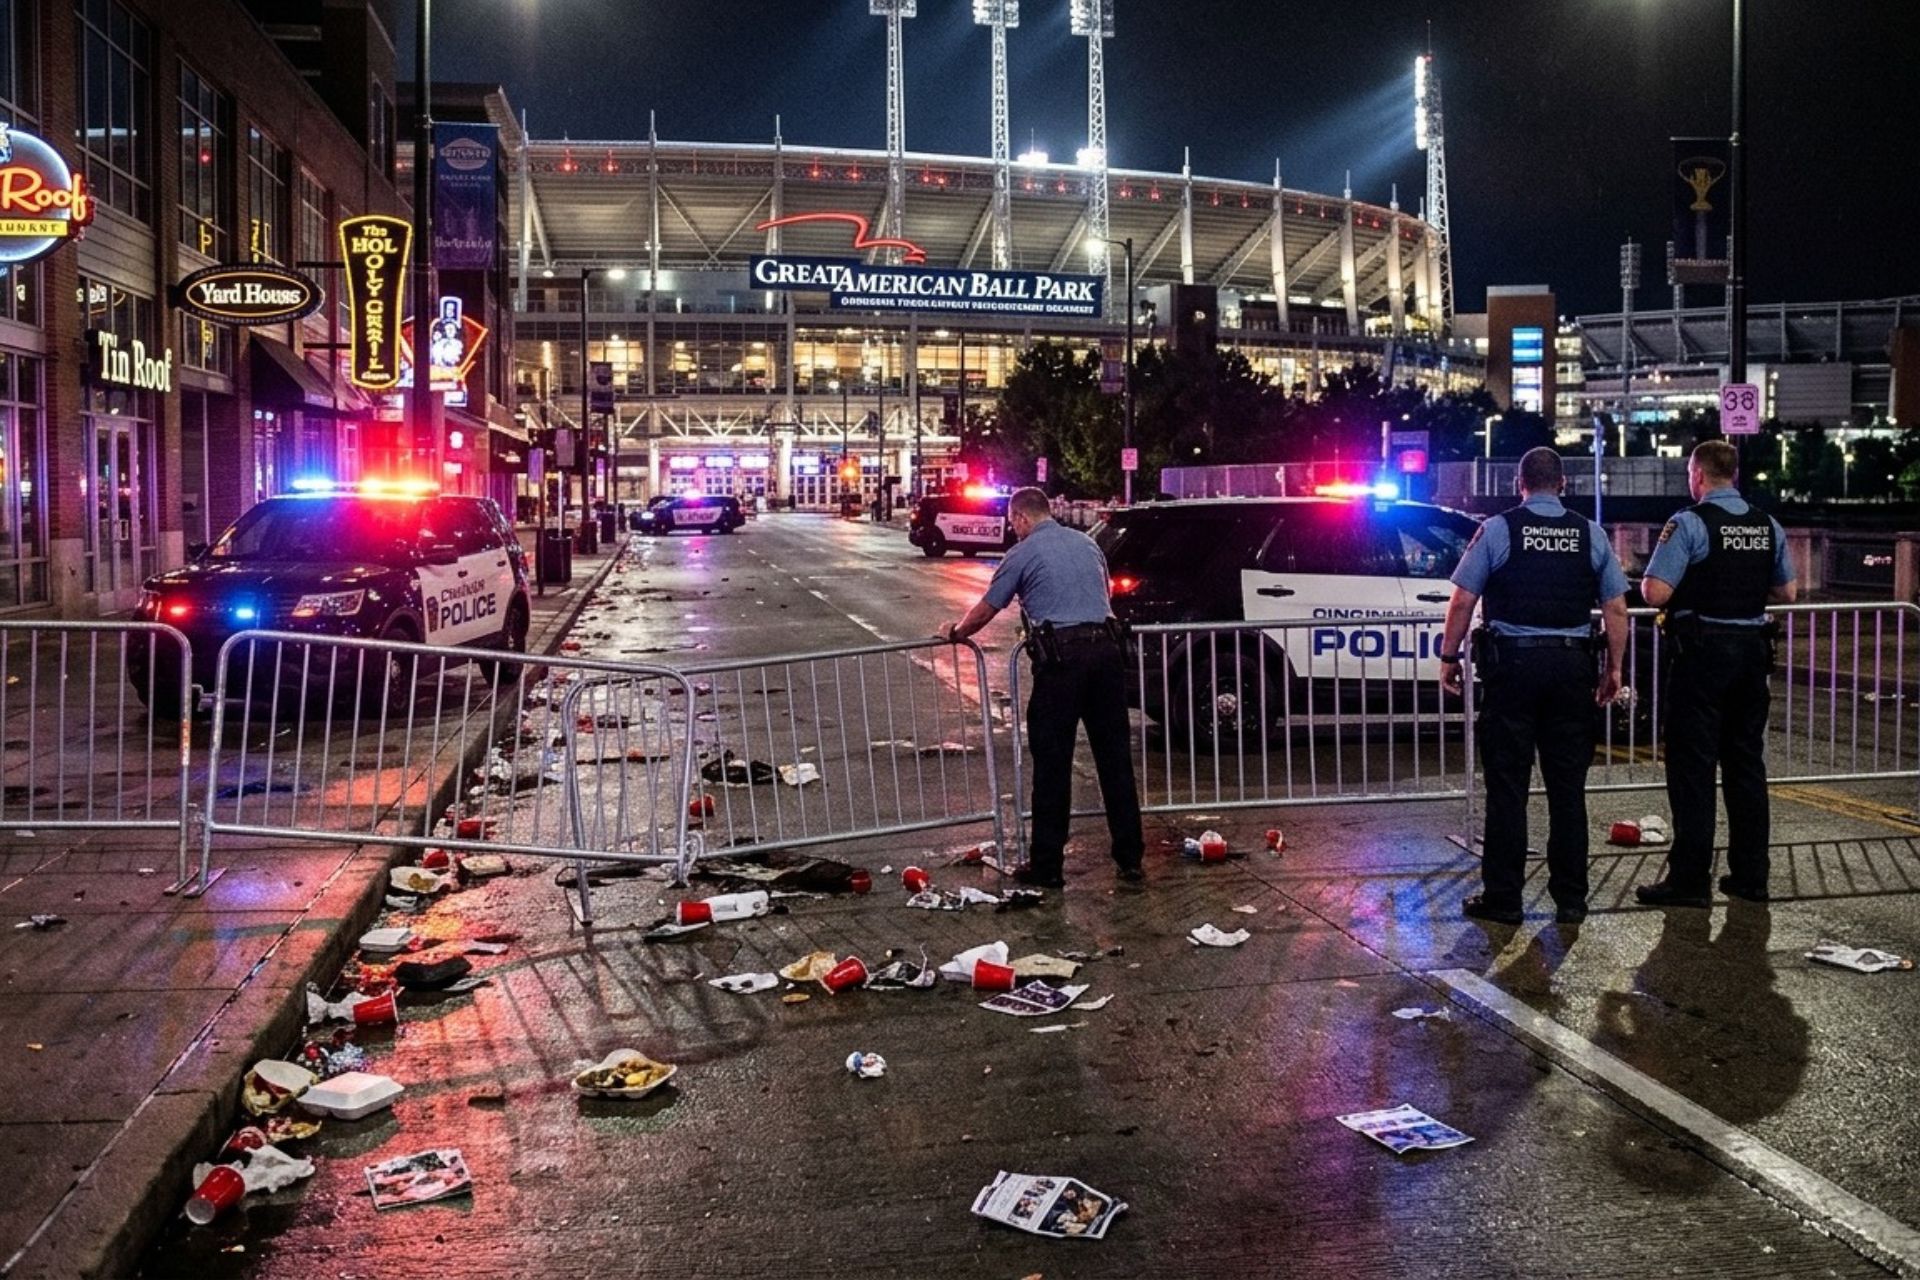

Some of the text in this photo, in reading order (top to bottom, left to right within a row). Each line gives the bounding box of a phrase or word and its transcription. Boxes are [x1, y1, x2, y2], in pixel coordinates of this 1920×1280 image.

[0, 167, 87, 221] Roof
[200, 283, 242, 304] Yard
[755, 259, 1097, 301] GREAT AMERICAN BALL PARK
[98, 331, 173, 393] Tin Roof
[1523, 536, 1580, 552] POLICE
[1723, 536, 1769, 550] POLICE
[441, 592, 496, 629] POLICE
